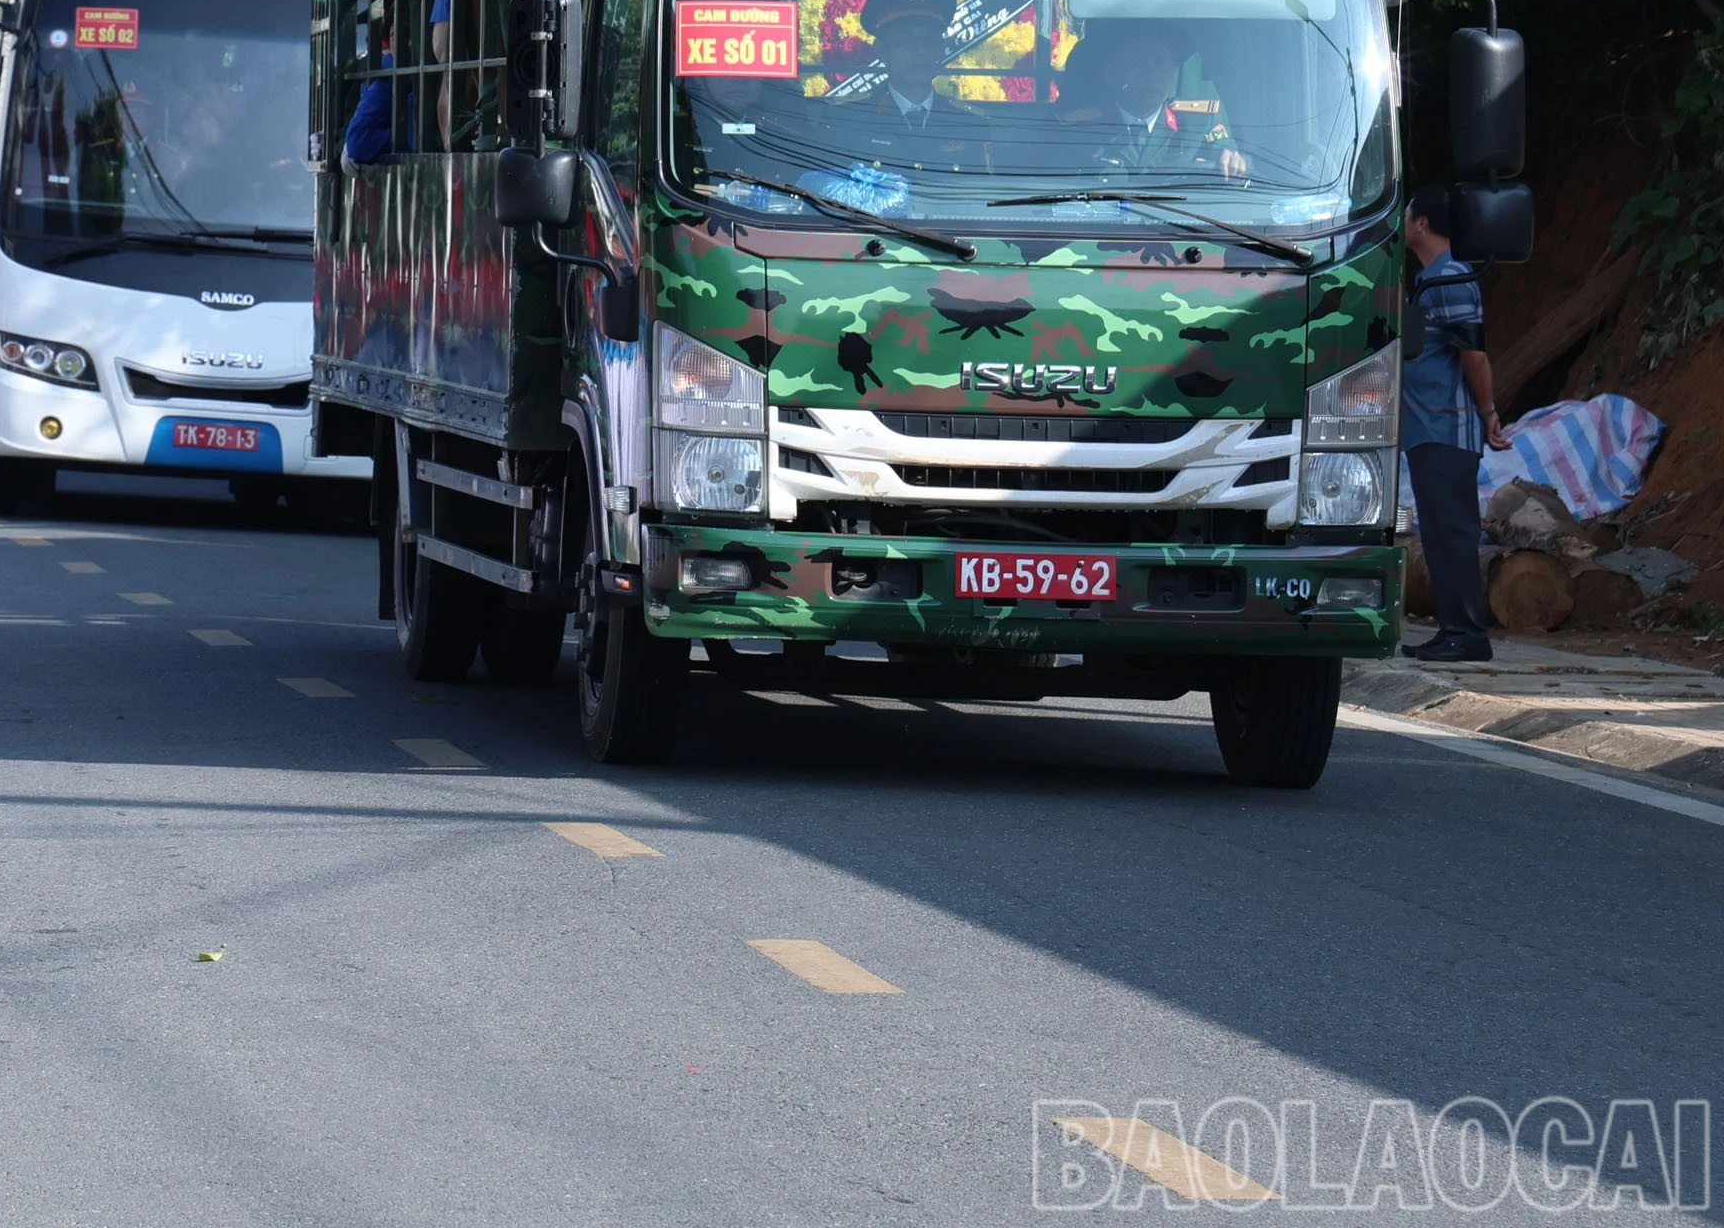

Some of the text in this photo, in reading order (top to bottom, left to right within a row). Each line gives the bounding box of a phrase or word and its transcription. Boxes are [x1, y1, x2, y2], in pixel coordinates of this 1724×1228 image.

[694, 9, 727, 22] CAM
[79, 23, 134, 43] XE SỐ 02
[687, 30, 787, 65] XE SỐ 01
[201, 291, 255, 306] SAMCO
[182, 350, 264, 370] ISUZU
[961, 361, 1117, 395] ISUZU
[960, 557, 1111, 597] KB-59-62
